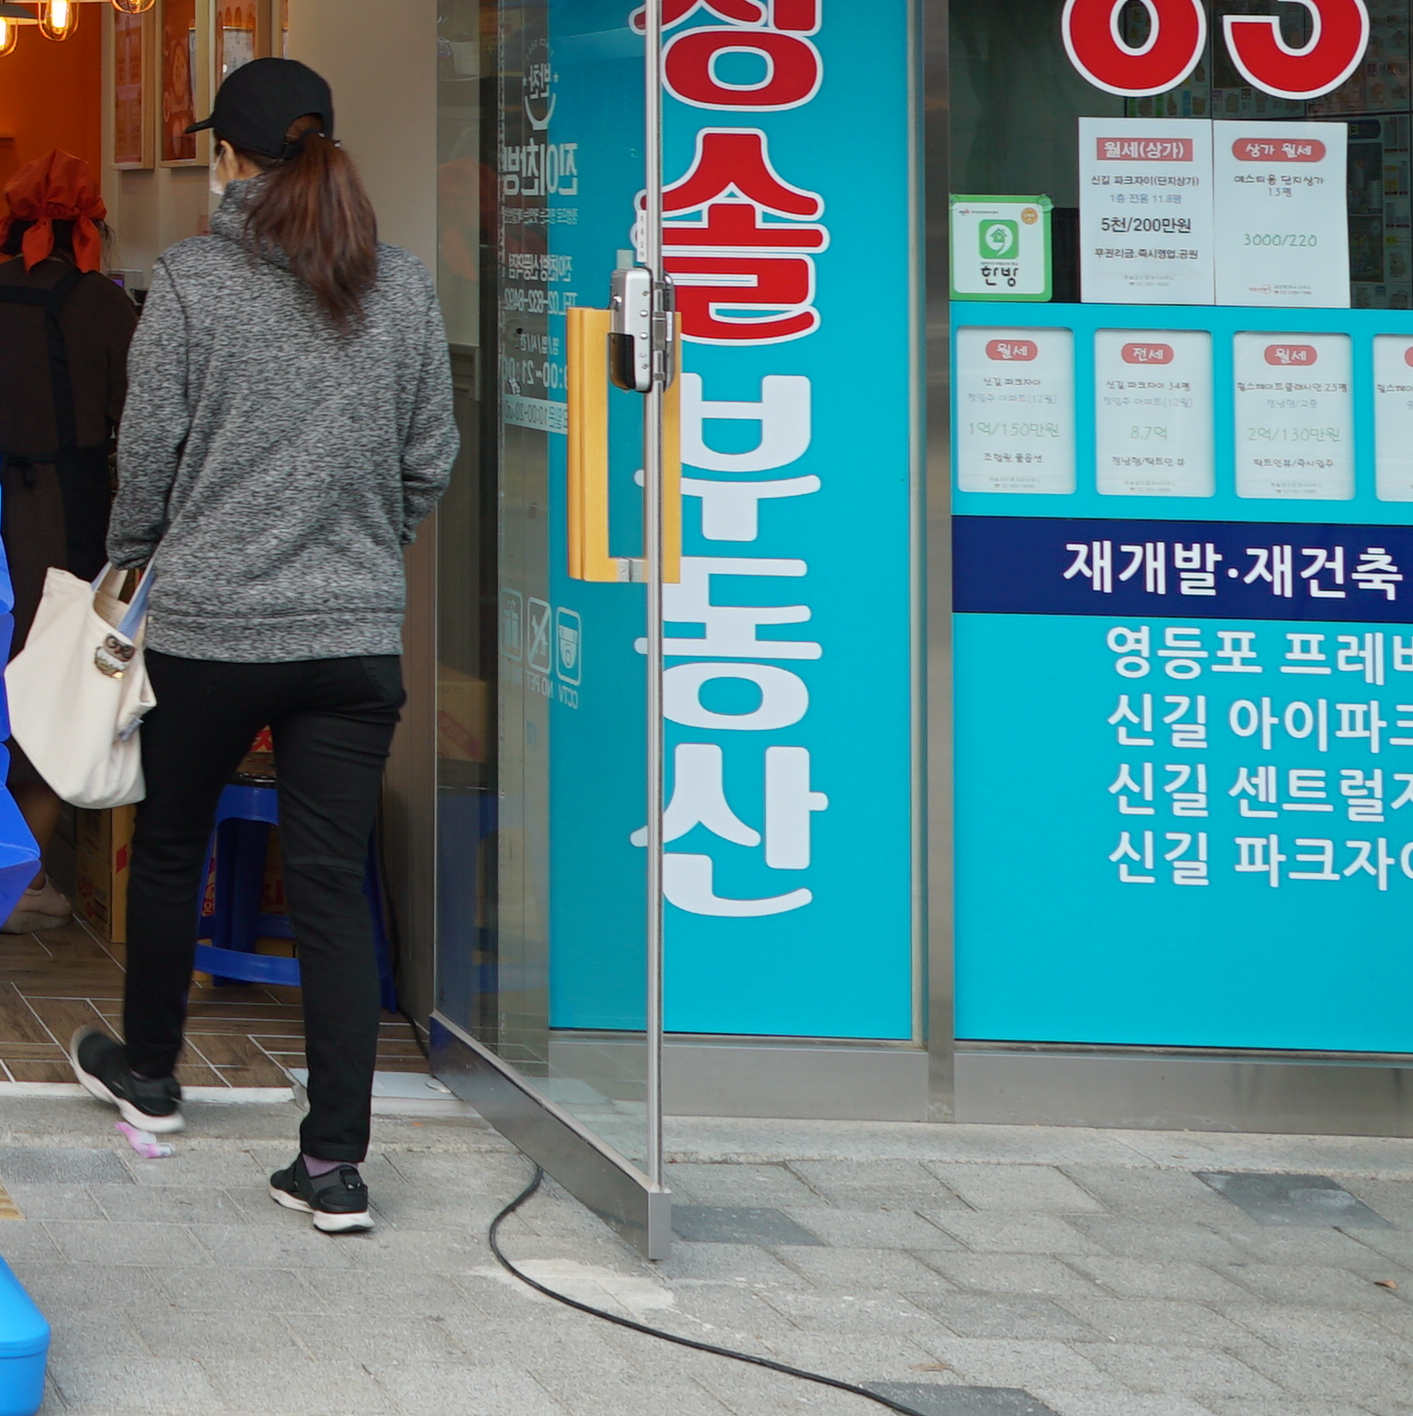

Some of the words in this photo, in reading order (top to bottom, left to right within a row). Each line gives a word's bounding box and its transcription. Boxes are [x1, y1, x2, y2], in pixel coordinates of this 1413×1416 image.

[1104, 141, 1184, 159] 월세(상가)
[1101, 217, 1191, 234] 5천/200만원
[1244, 233, 1318, 248] 3000/220
[980, 266, 1019, 288] 한방
[997, 343, 1028, 359] 월세
[1133, 347, 1164, 362] 전세
[1275, 348, 1307, 364] 월세
[1106, 625, 1263, 680] 영등포
[1107, 693, 1209, 749] 신길
[1107, 762, 1210, 818] 신길
[1108, 830, 1210, 886] 신길
